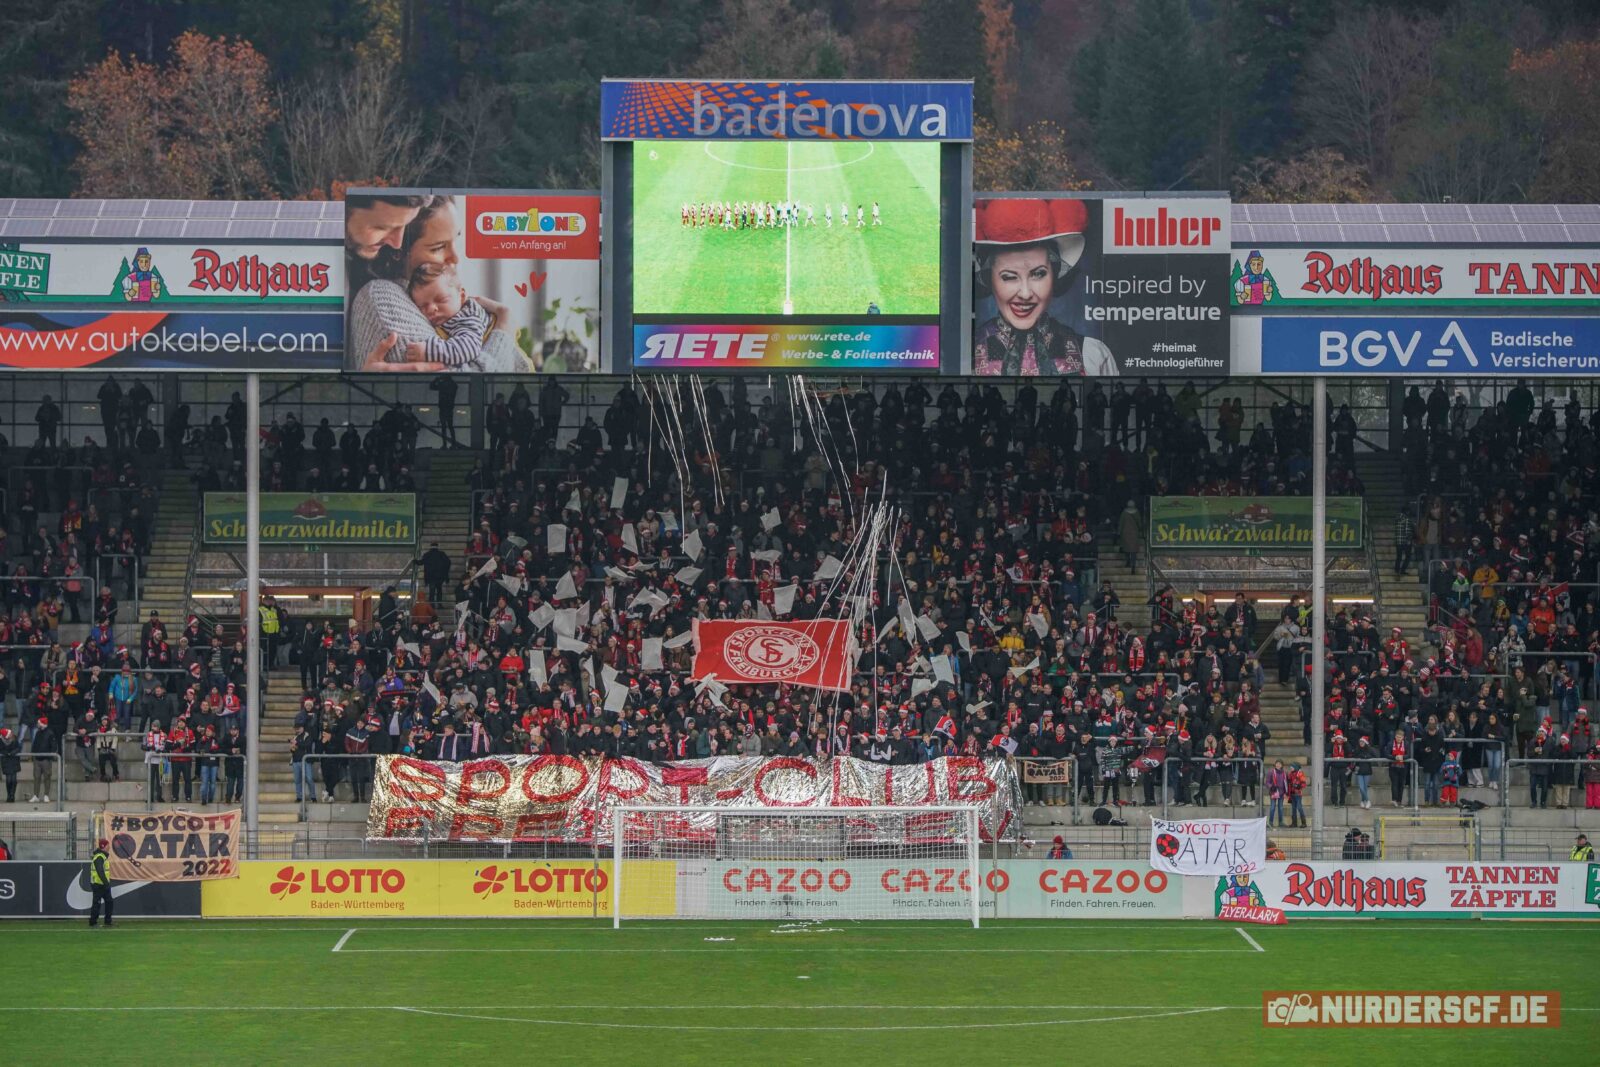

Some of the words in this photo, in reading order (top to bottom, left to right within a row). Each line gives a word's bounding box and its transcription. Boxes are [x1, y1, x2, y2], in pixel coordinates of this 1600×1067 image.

[693, 90, 947, 136] badenova
[1114, 207, 1221, 246] huber
[519, 240, 551, 251] Anfang
[553, 240, 566, 249] an!
[188, 248, 330, 299] Rothaus
[1301, 251, 1443, 301] Rothaus
[1085, 275, 1172, 298] Inspired
[1179, 275, 1206, 298] by
[1084, 305, 1221, 325] temperature
[0, 326, 327, 352] www.autokabel.com
[786, 331, 872, 341] www.rete.de
[782, 350, 827, 359] Werbe-
[832, 350, 841, 359] &
[844, 349, 935, 360] Folientechnik
[1152, 343, 1196, 353] #heimat
[1319, 330, 1421, 367] BGV
[1491, 331, 1573, 347] Badische
[1125, 357, 1224, 369] #Technologieführer
[1491, 352, 1600, 368] Versicherun
[209, 519, 410, 538] Scharzwaldmilch
[1156, 523, 1355, 542] Schwarzwaldmlch
[729, 648, 794, 678] FREIBURG
[111, 814, 235, 832] #BOYCOTT
[1154, 820, 1231, 835] #BOYCOTT
[182, 859, 231, 876] 2022
[1227, 862, 1256, 874] 2022
[311, 869, 405, 893] LOTTO
[514, 869, 608, 893] LOTTO
[722, 868, 852, 893] CAZOO
[881, 868, 1010, 893] CAZOO
[1039, 869, 1168, 893] CAZOO
[1282, 863, 1427, 914] Rothaus
[1446, 866, 1560, 884] TANNEN
[311, 900, 405, 910] Baden-Württemberg
[514, 899, 607, 910] Baden-Württembrg
[1051, 899, 1083, 908] Finden.
[1086, 899, 1120, 908] Fahren.
[1122, 899, 1156, 908] Freuen.
[1450, 885, 1556, 908] ZÄPFLE
[1219, 905, 1279, 922] FLYERALARM
